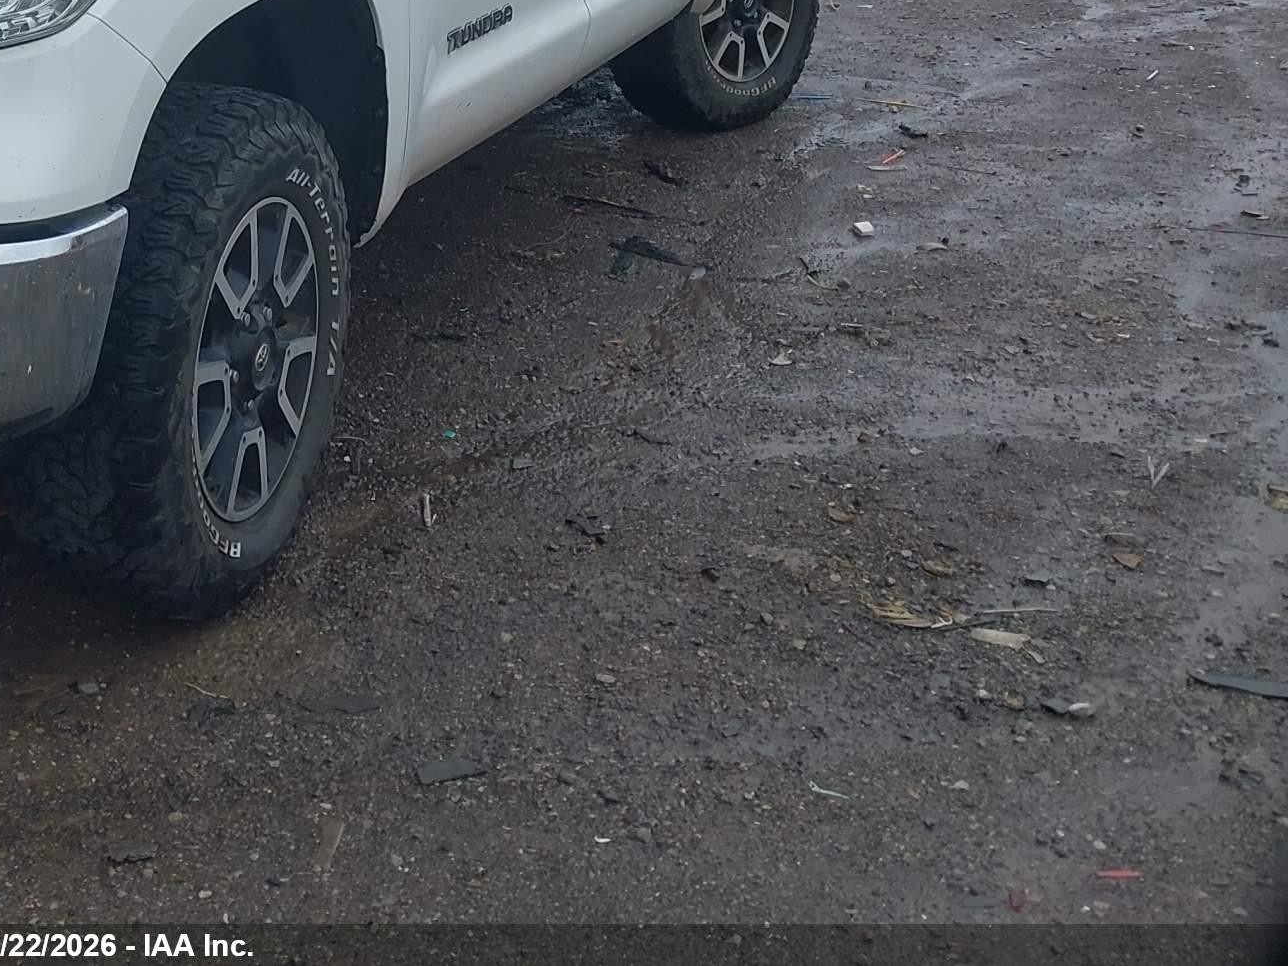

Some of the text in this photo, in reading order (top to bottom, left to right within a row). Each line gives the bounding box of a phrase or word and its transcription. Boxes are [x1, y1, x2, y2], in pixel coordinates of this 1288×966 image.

[446, 2, 514, 55] TUNDRA
[285, 168, 341, 376] All-Terrain T/A
